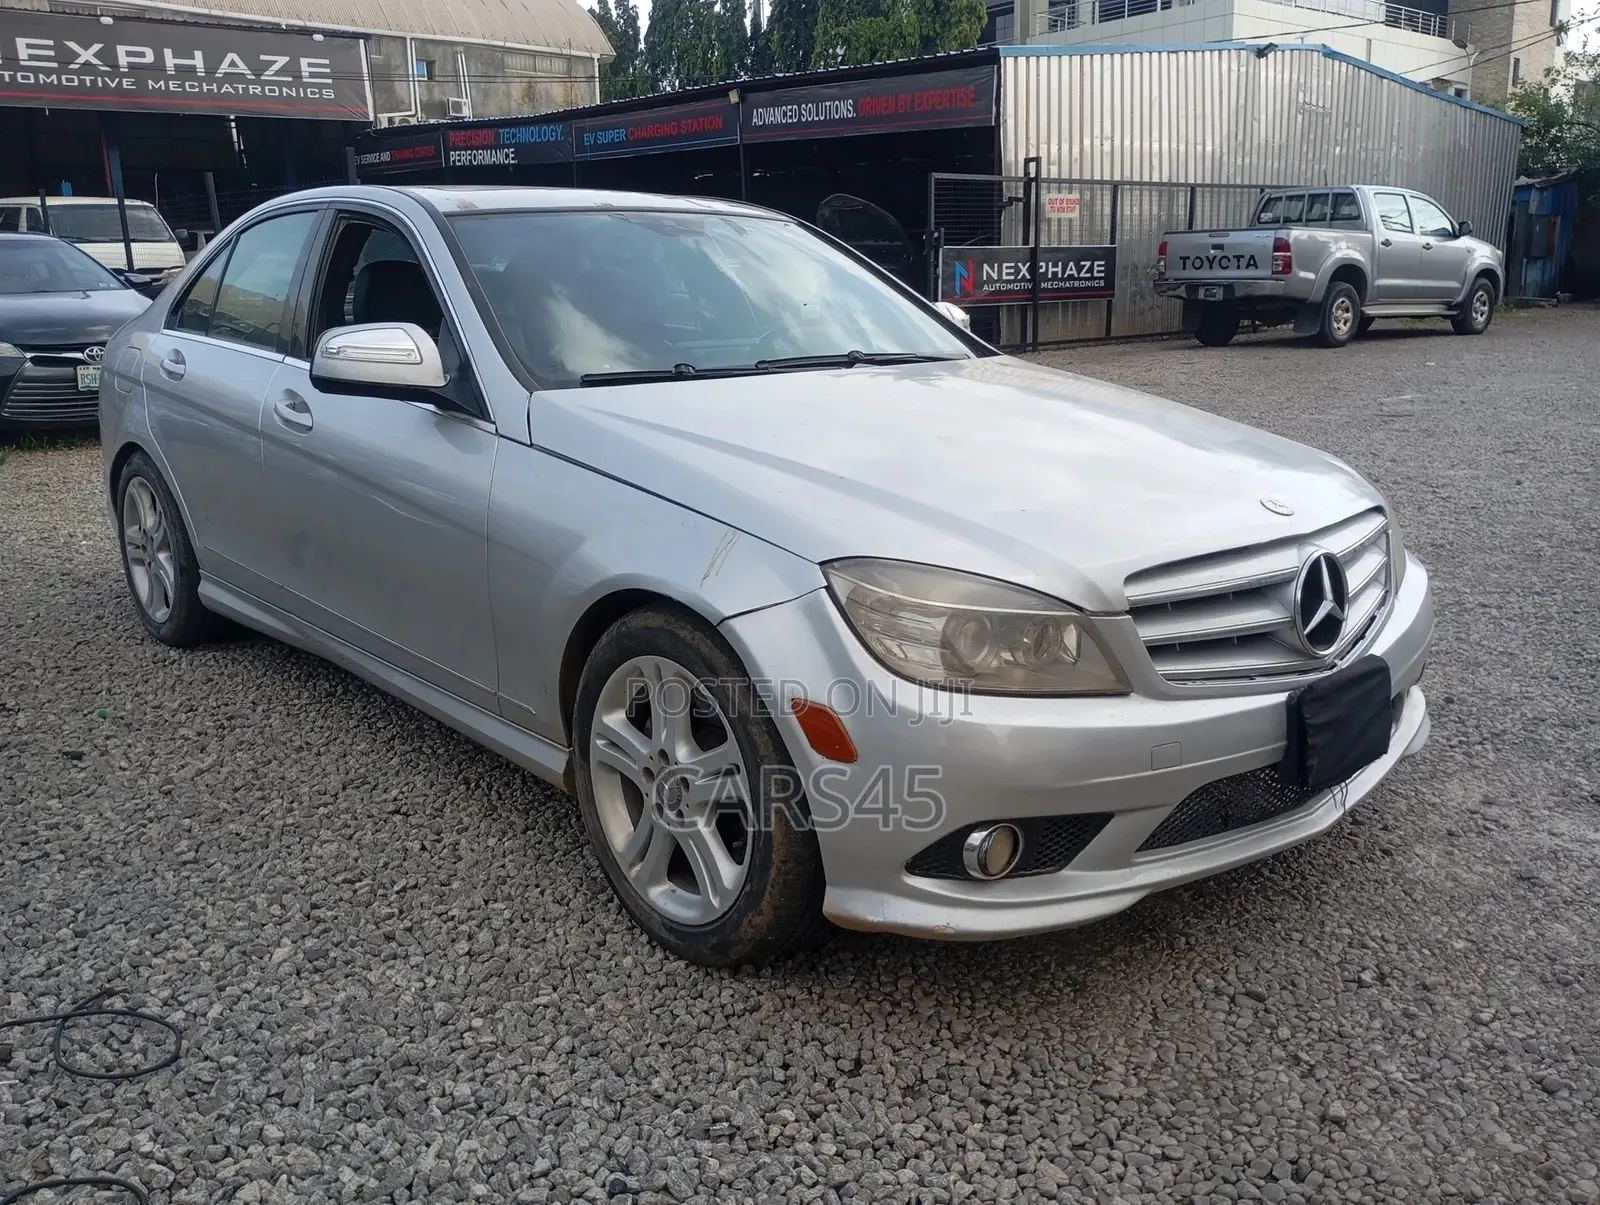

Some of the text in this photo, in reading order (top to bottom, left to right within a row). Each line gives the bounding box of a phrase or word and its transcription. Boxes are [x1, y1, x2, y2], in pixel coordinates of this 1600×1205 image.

[0, 37, 333, 84] EXPHAZE
[147, 79, 335, 99] MECHATRONICS
[752, 105, 799, 126] ADVANCED
[800, 99, 856, 122] SOLUTIONS.
[859, 94, 896, 117] DRIVEN
[898, 93, 912, 113] BY
[499, 124, 564, 145] TECHNOLOGY.
[583, 115, 723, 146] EV SUPER CHARGING STATION
[360, 152, 380, 165] SERVICE
[380, 151, 391, 162] AND
[450, 148, 518, 166] PERFORMANCE.
[1179, 254, 1259, 271] TOYOTA
[982, 279, 1105, 292] AUTOMOTIV MECHATRONICS
[80, 373, 100, 385] RSH-
